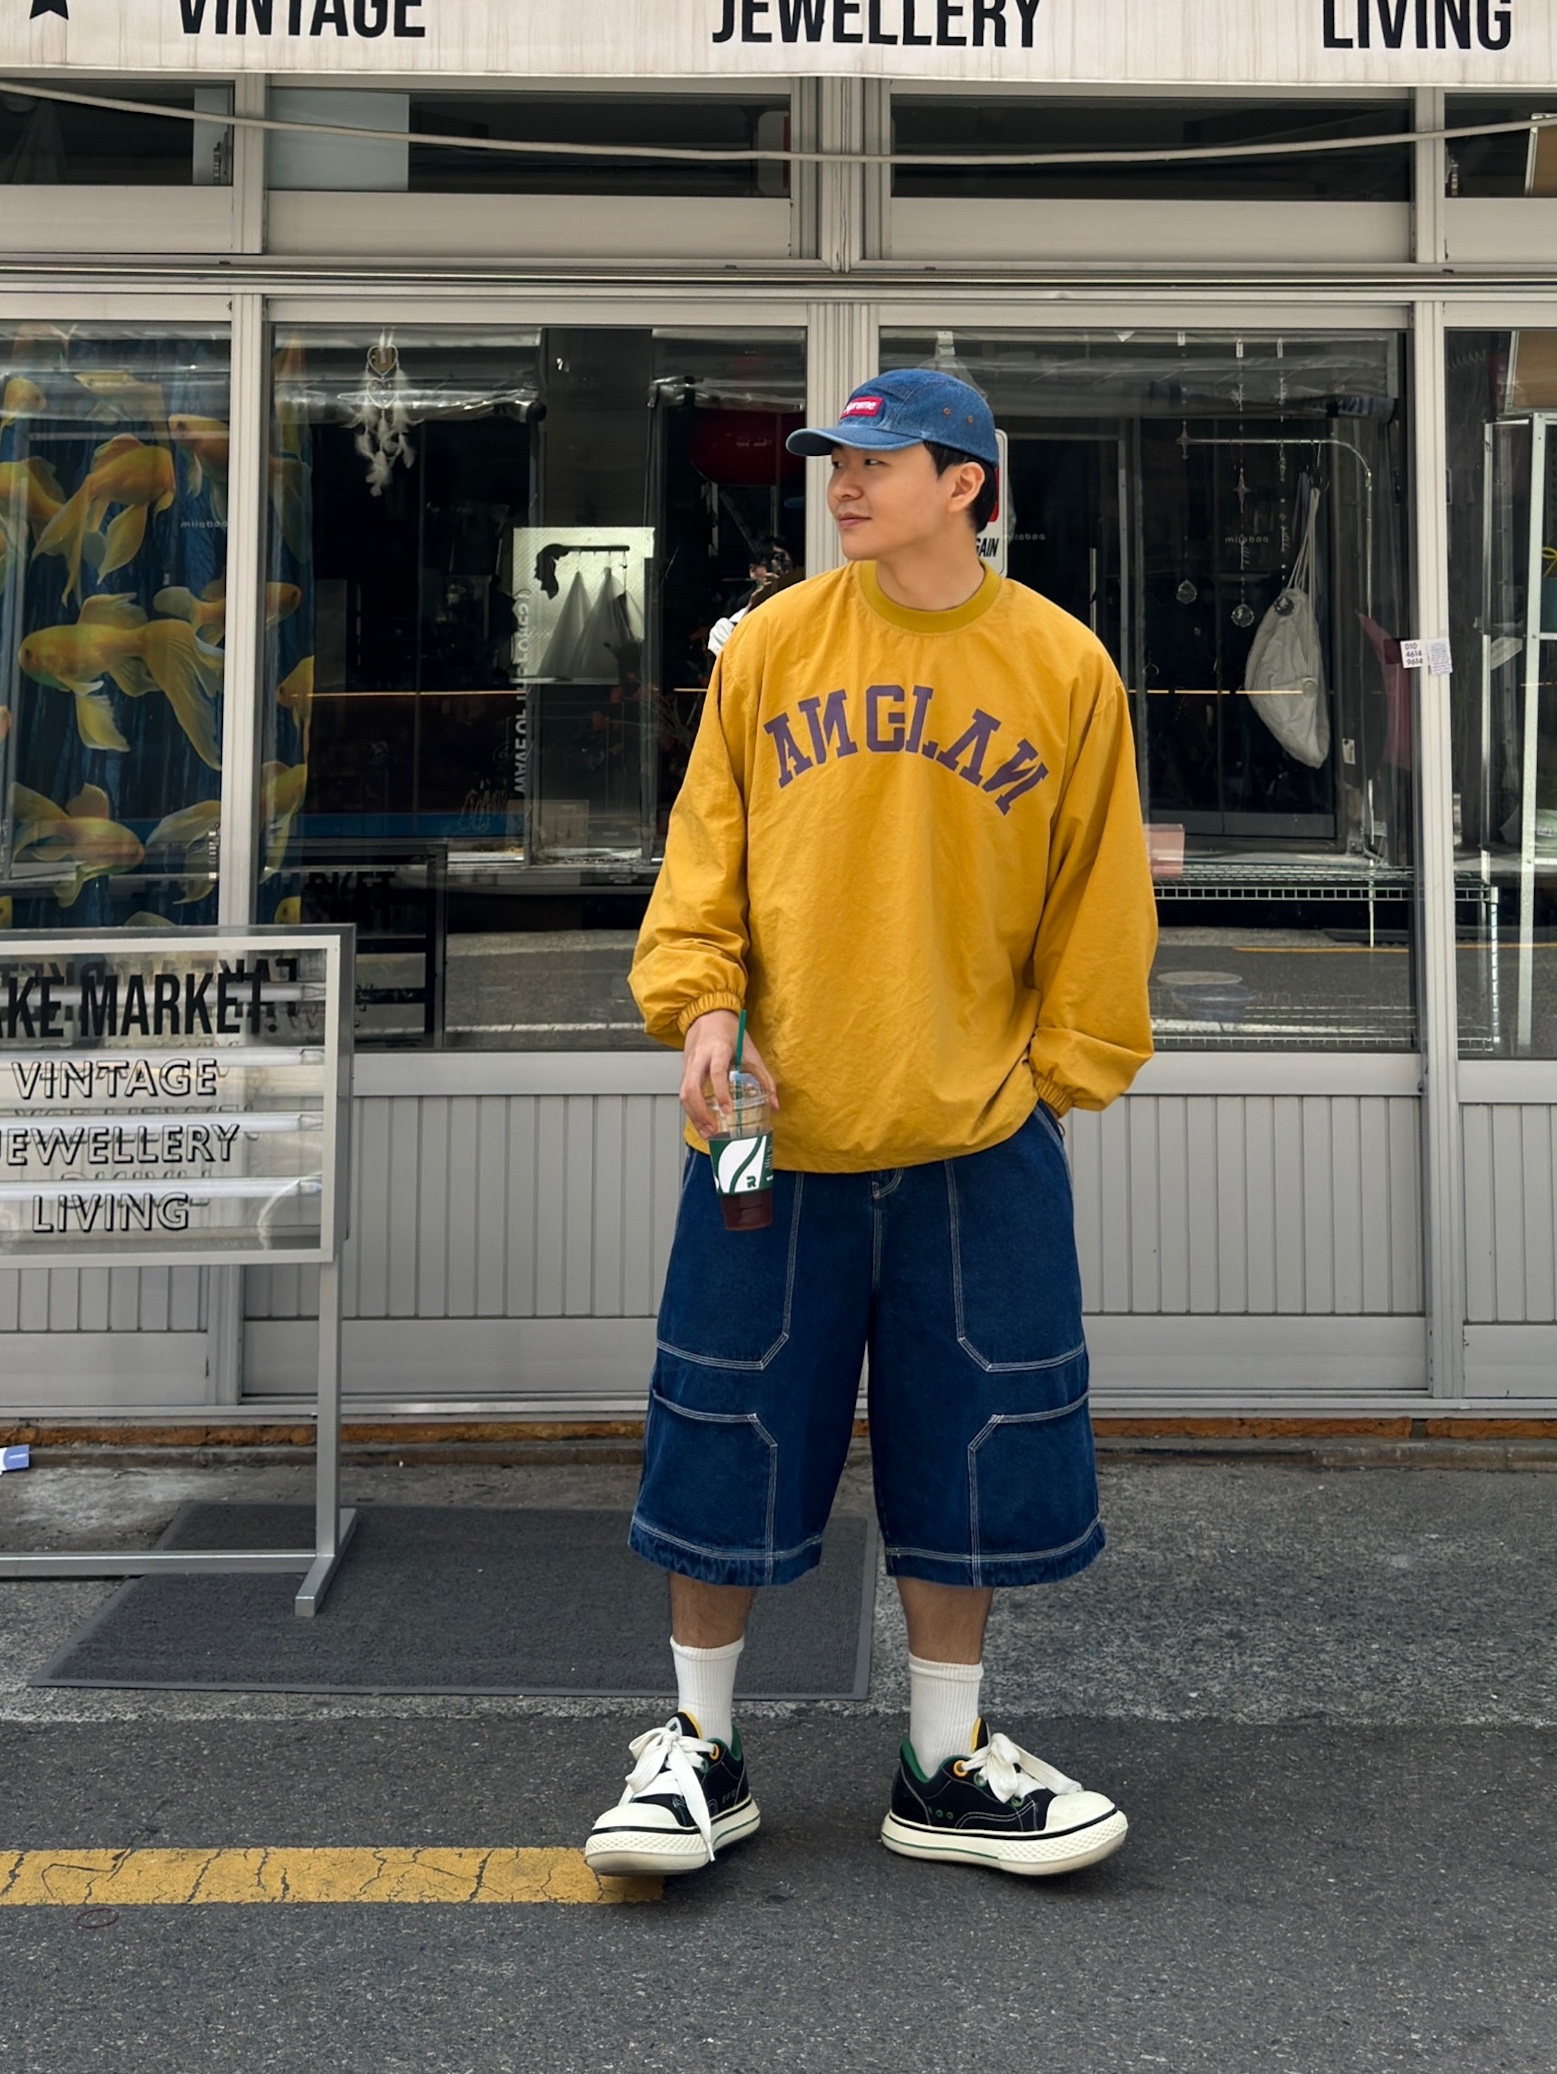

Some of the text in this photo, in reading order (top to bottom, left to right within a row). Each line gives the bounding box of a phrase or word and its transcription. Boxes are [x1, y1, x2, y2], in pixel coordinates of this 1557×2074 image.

[712, 0, 1040, 48] JEWELLERY
[1323, 0, 1512, 50] LIVING
[0, 974, 64, 1038] KE
[11, 1058, 218, 1100] VINTAGE
[0, 1123, 241, 1166] EWELLERY
[31, 1192, 190, 1233] LIVING
